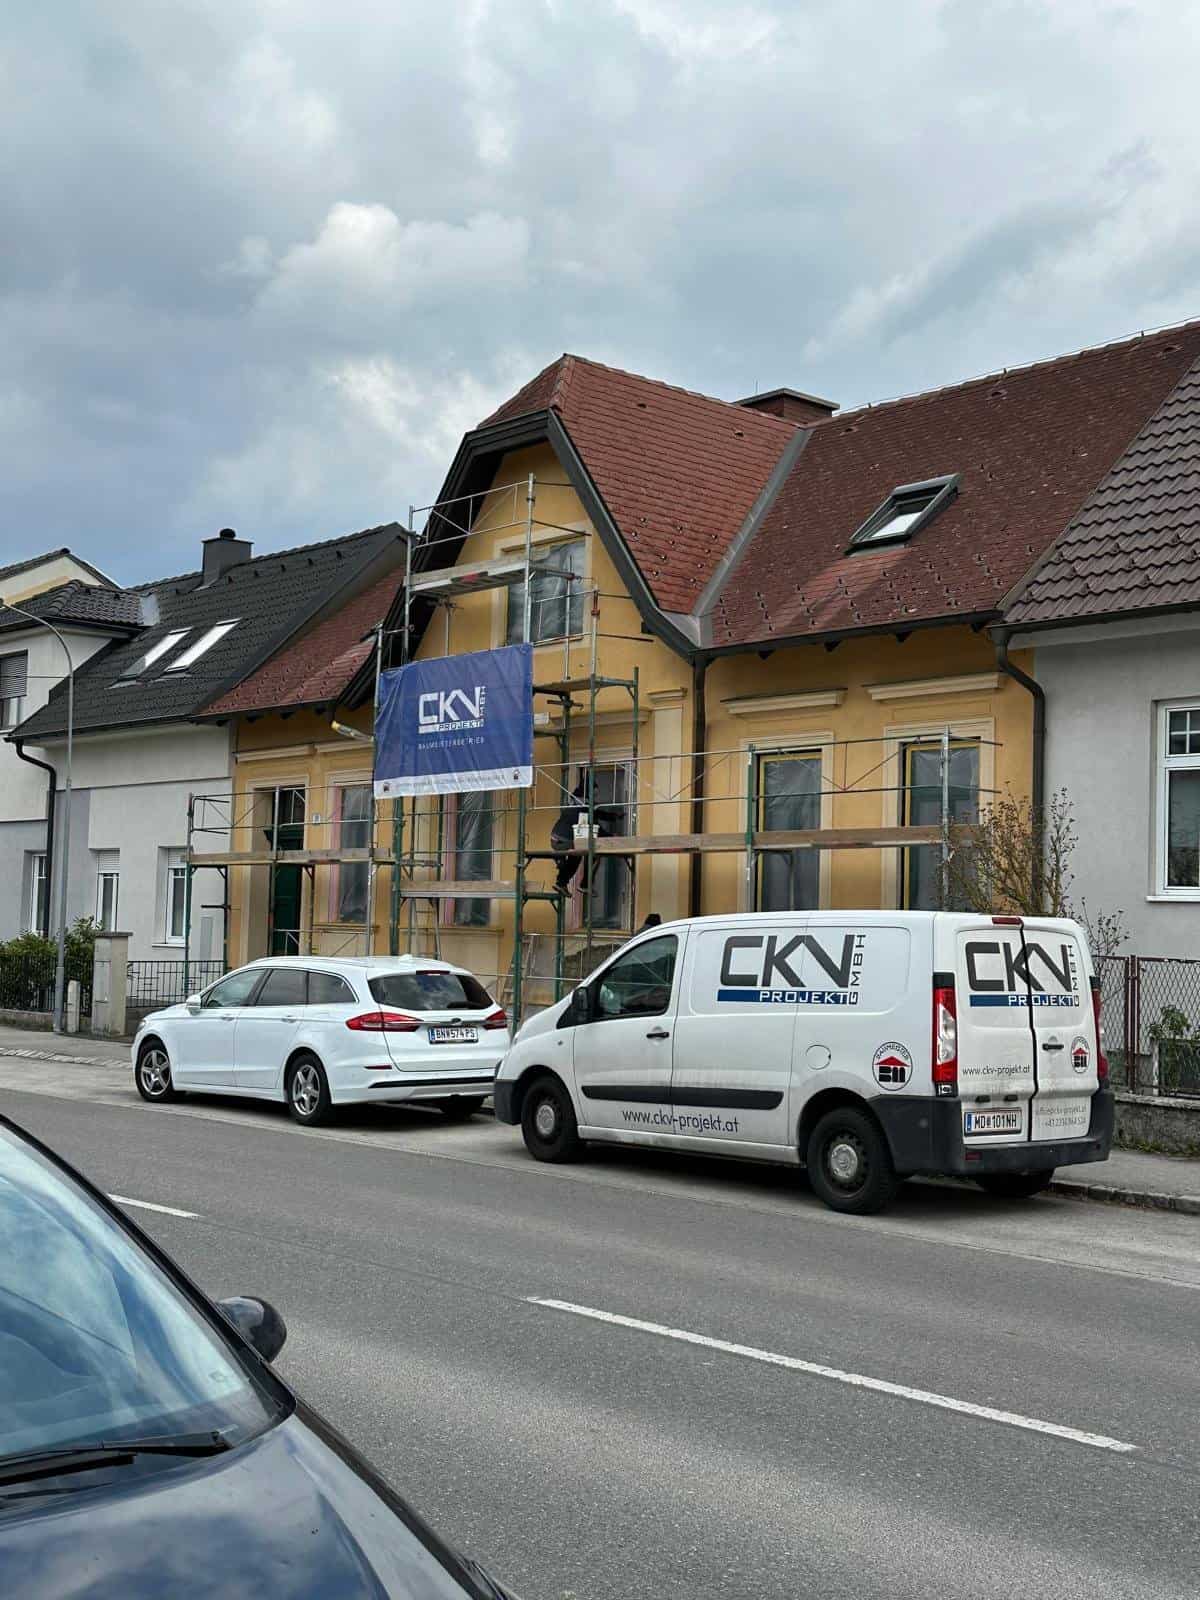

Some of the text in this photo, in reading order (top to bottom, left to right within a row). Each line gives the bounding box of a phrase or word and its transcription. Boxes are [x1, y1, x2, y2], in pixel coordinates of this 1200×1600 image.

[848, 934, 867, 1005] GMBH
[759, 990, 849, 1005] PROJEKT
[1008, 995, 1073, 1007] PROJEKT
[963, 1064, 1030, 1077] www.ckv-projekt.at
[622, 1110, 739, 1133] www.ckv-projekt.at
